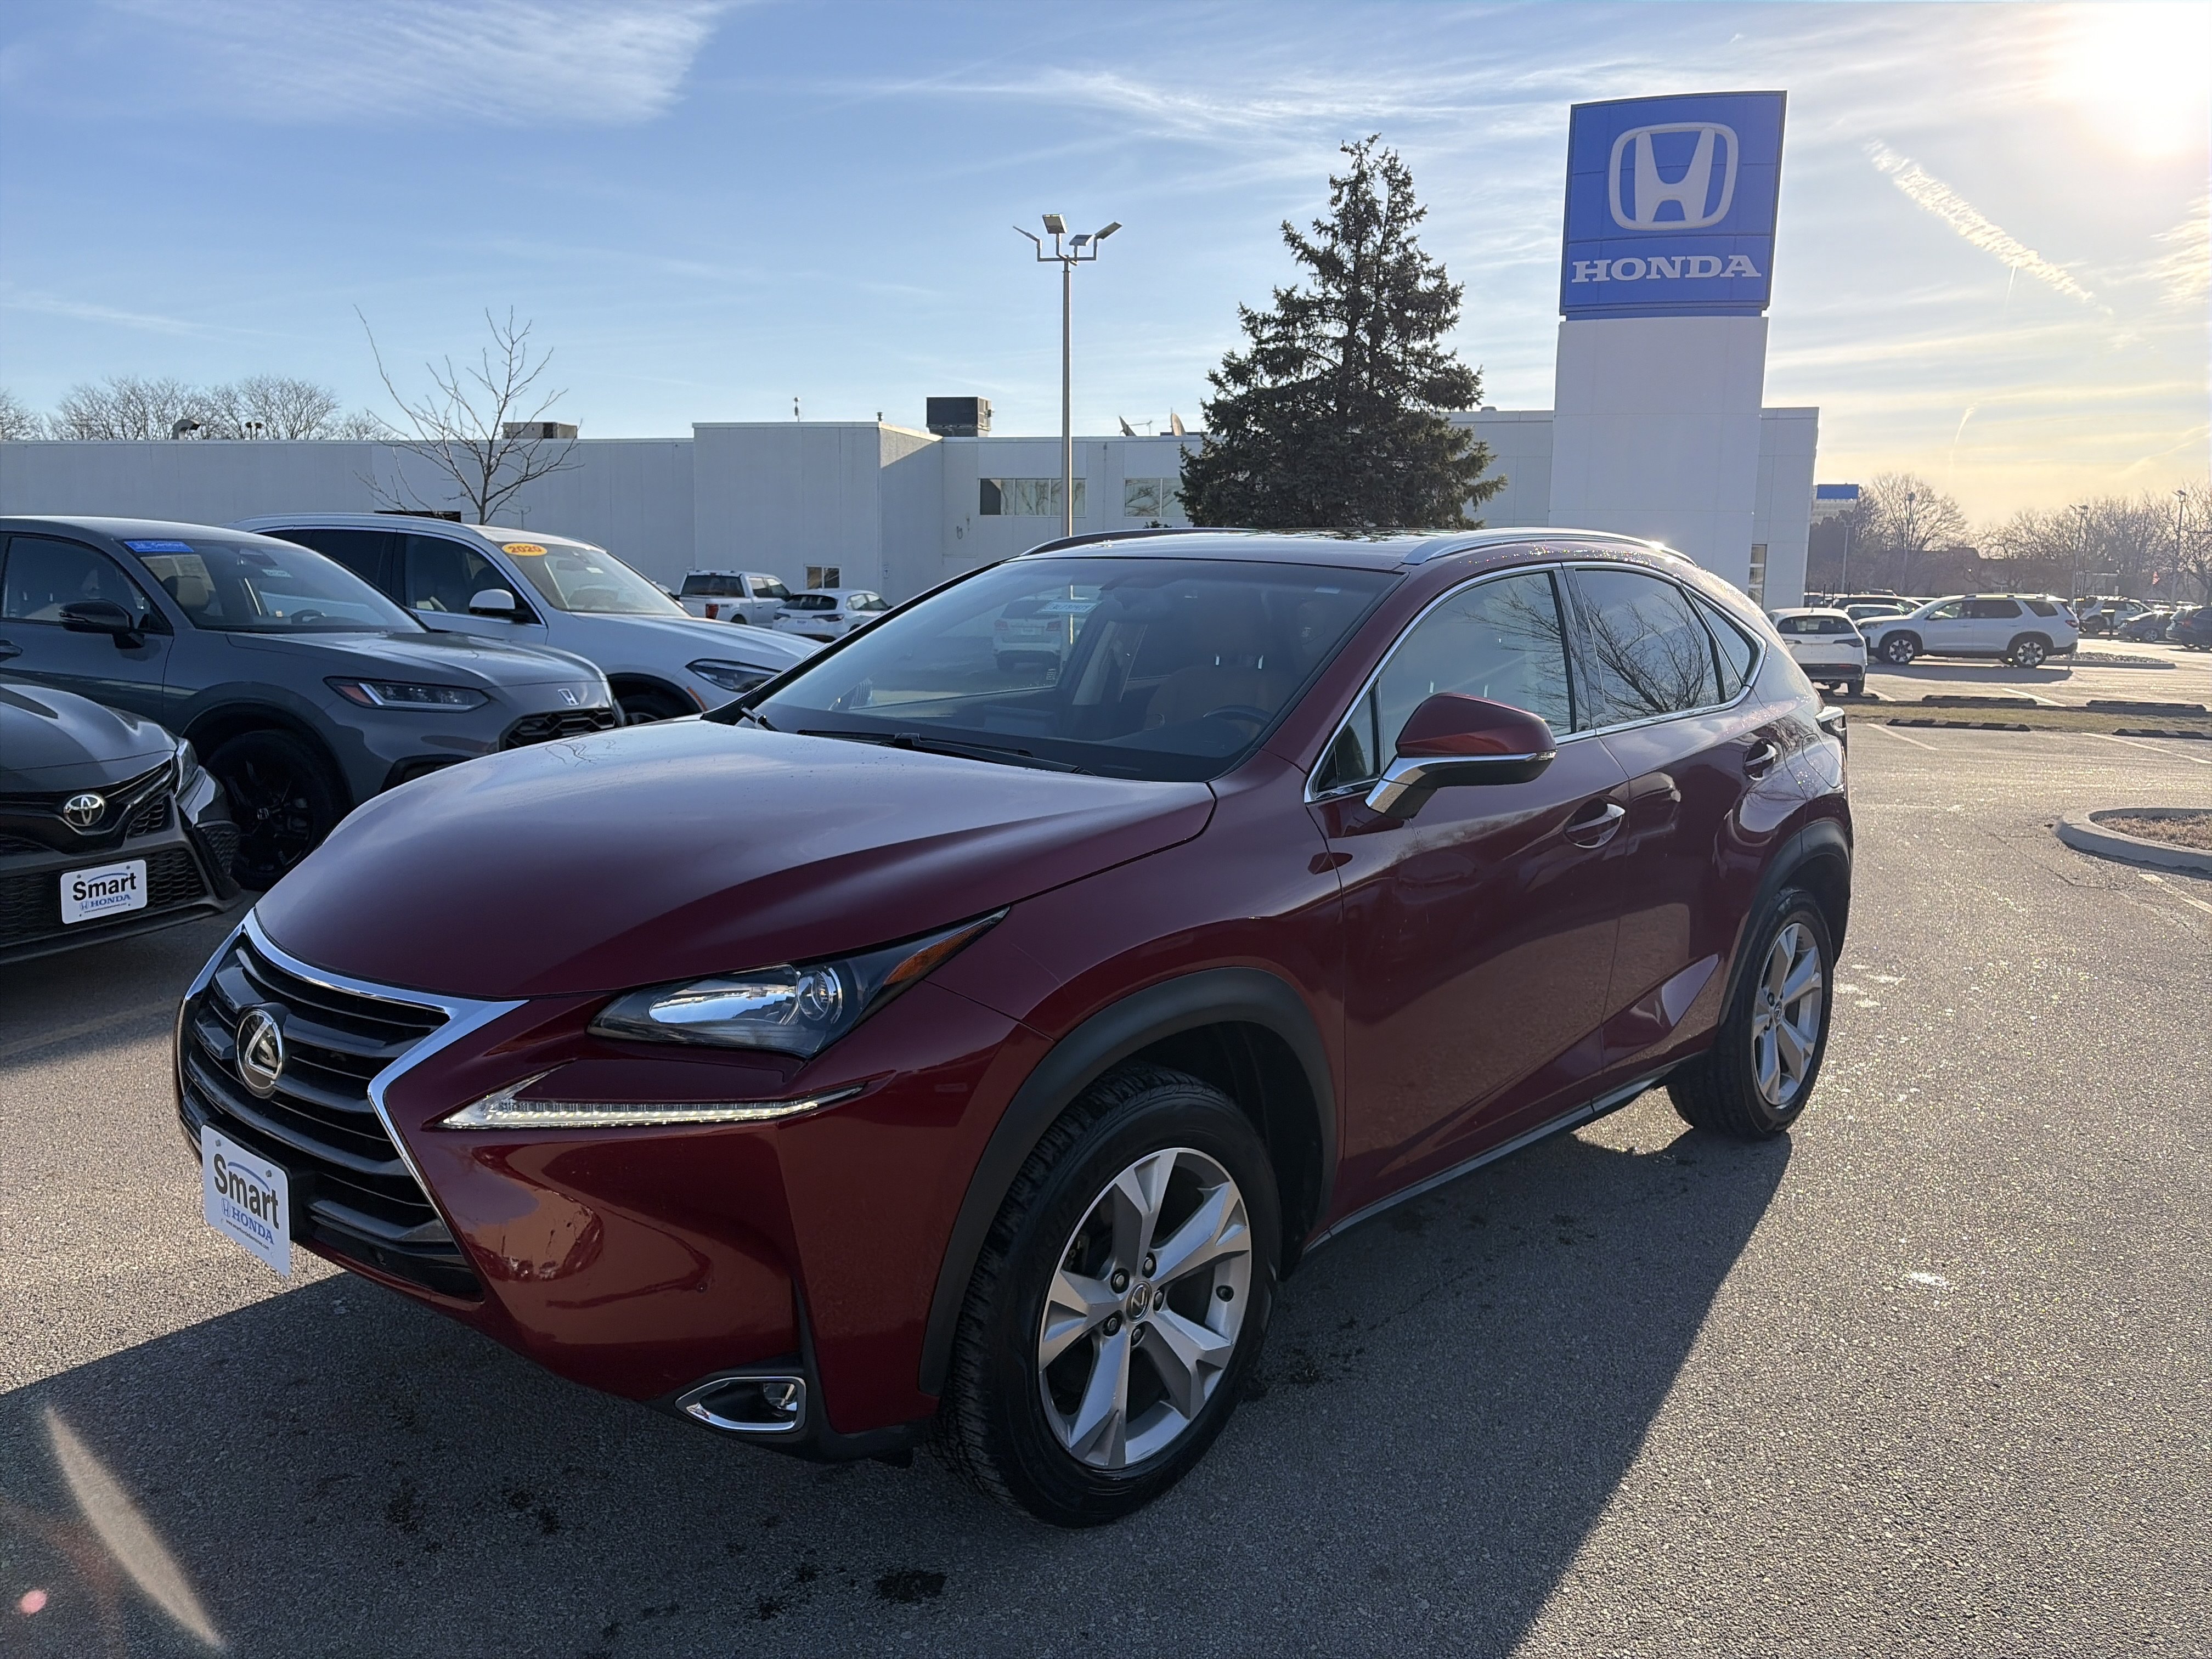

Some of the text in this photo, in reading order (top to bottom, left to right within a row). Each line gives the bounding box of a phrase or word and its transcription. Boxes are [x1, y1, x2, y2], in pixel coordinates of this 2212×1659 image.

[1572, 255, 1762, 283] HONDA
[73, 872, 136, 901] Smart
[91, 894, 131, 907] HONDA
[214, 1153, 279, 1229] Smart
[232, 1206, 274, 1245] HONDA
